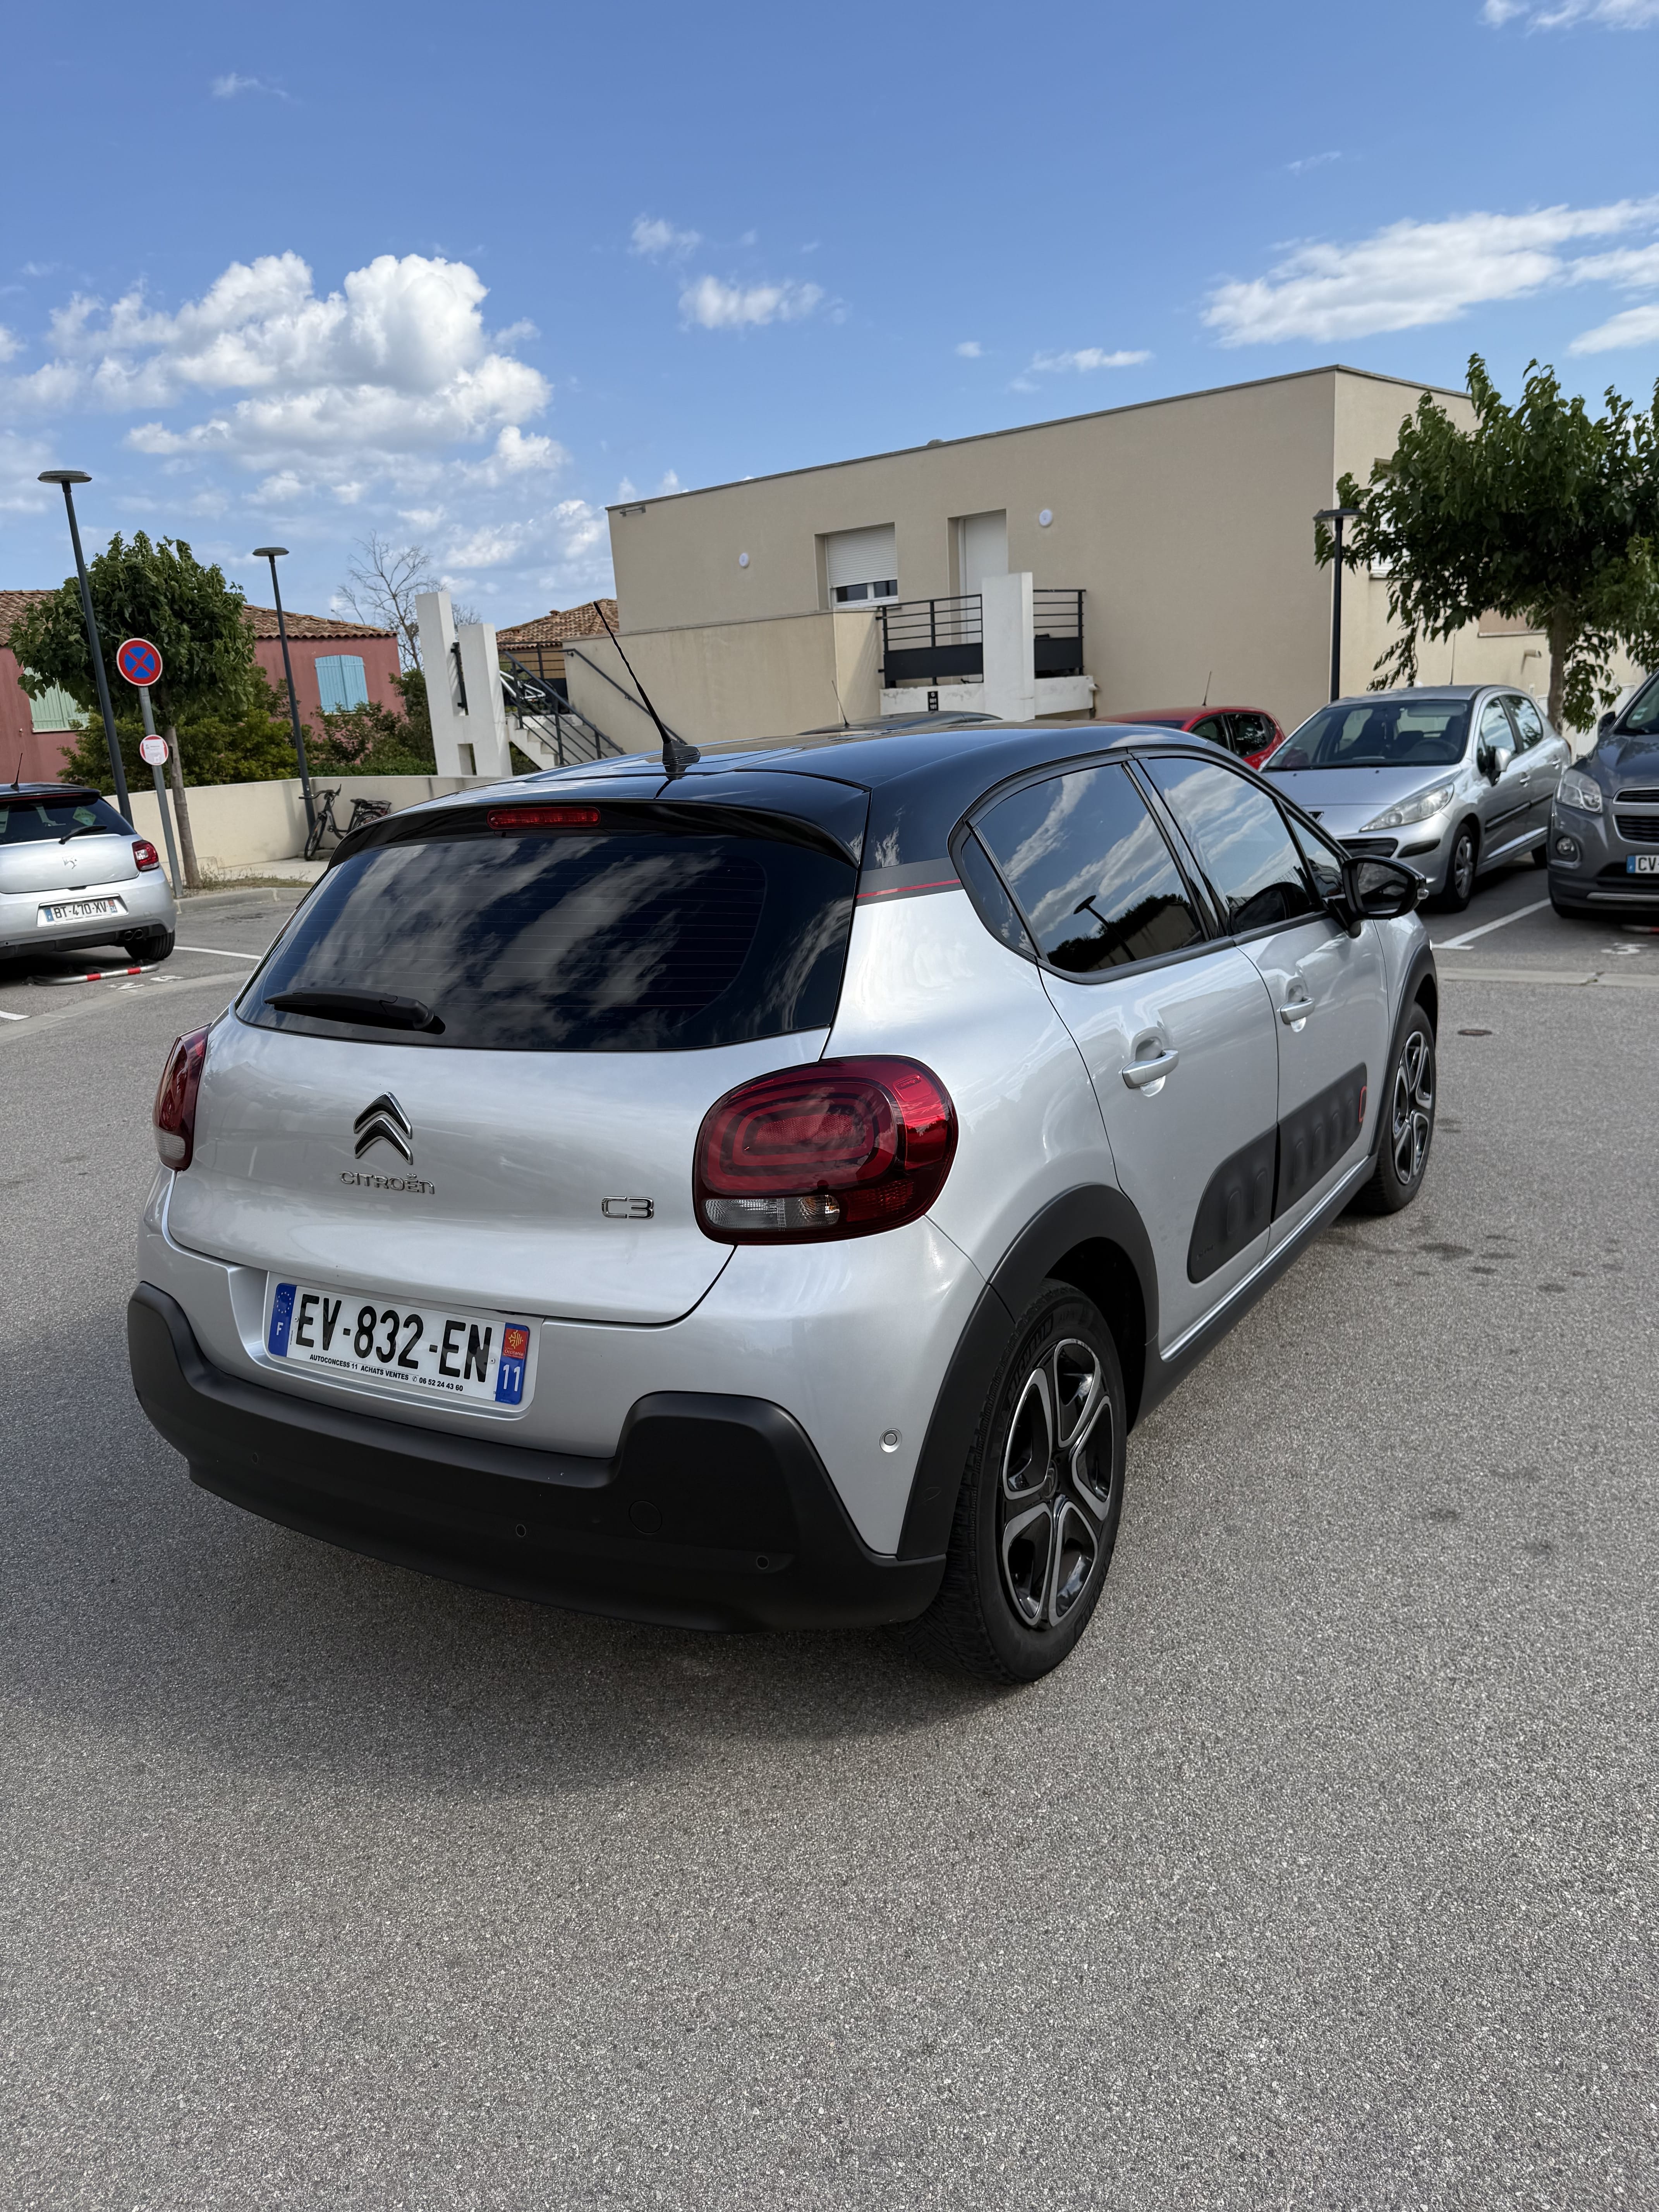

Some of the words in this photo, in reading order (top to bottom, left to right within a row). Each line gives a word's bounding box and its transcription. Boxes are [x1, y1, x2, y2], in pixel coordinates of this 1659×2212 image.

[53, 901, 107, 919] BT-470-XV
[339, 1167, 434, 1194] CITROËN
[601, 1196, 654, 1219] C3
[276, 1321, 284, 1336] F
[295, 1294, 492, 1383] EV-832-EN
[310, 1354, 350, 1368] AUTOCONCESS
[361, 1365, 384, 1375] ACHATS
[385, 1370, 409, 1381] VENTES
[503, 1364, 520, 1392] 11
